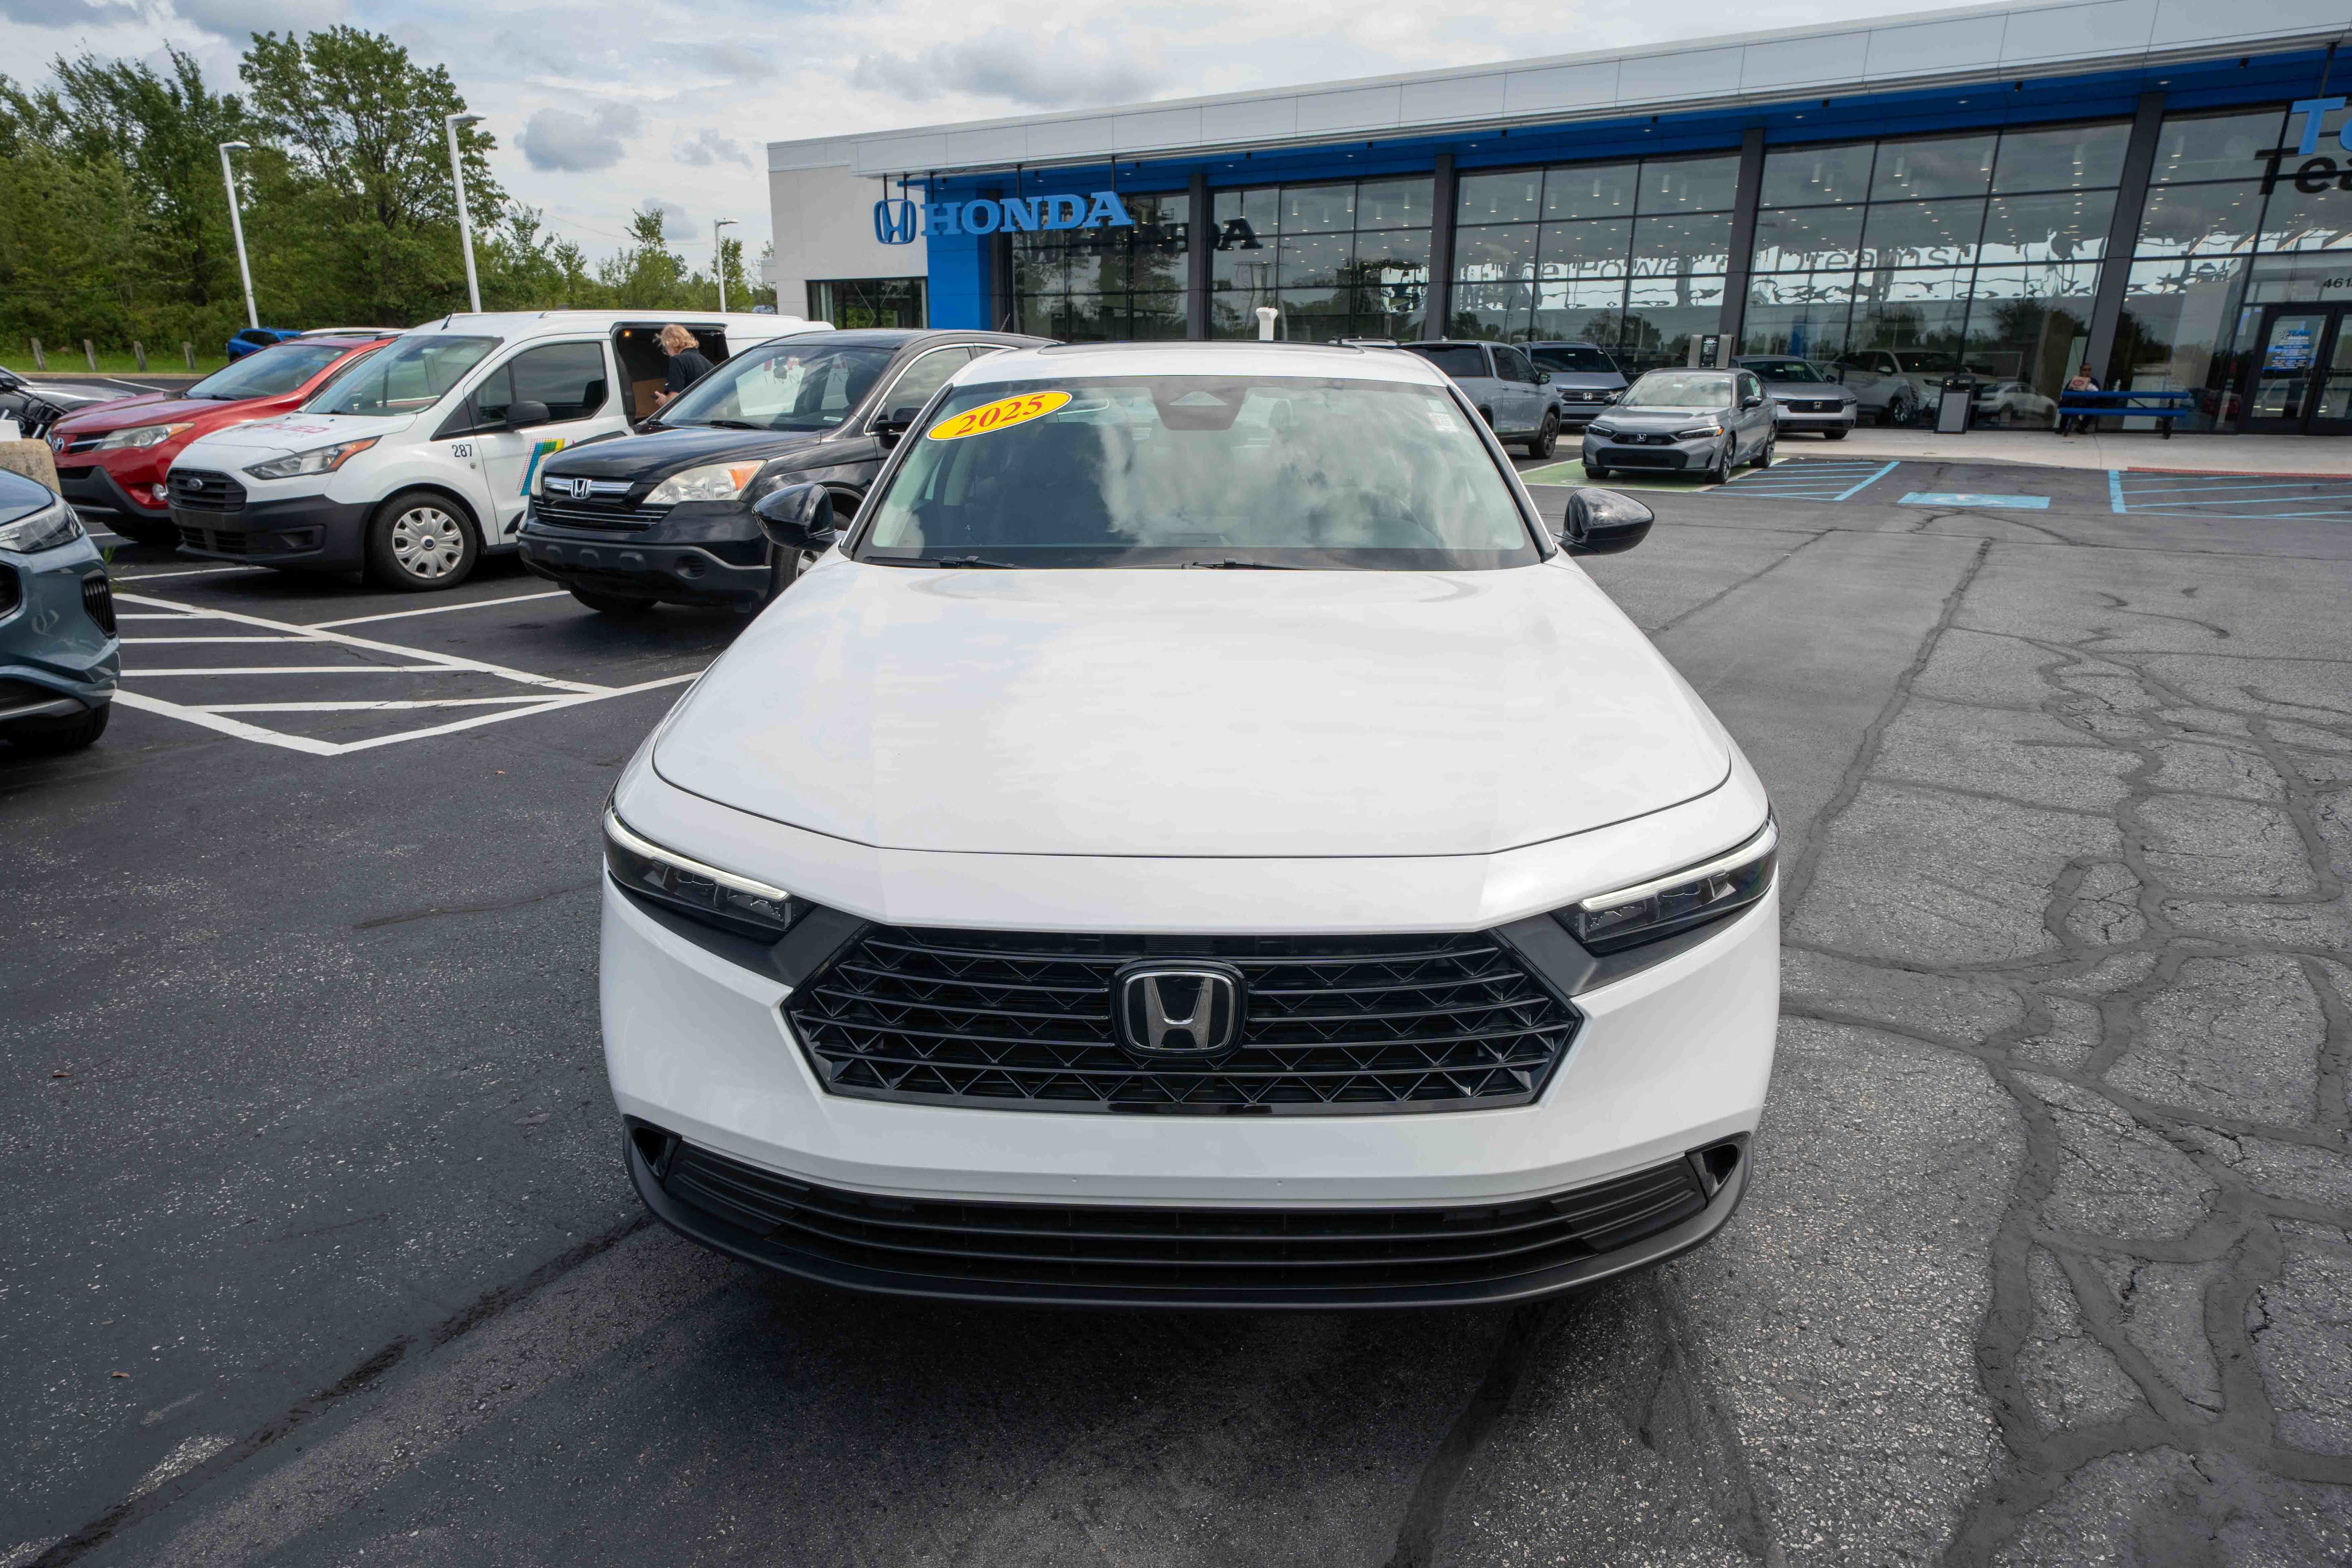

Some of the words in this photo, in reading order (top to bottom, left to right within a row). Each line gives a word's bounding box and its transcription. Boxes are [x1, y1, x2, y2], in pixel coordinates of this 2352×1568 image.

[2290, 96, 2352, 155] T
[920, 191, 1135, 236] HONDA
[2323, 277, 2352, 289] 461
[954, 394, 1046, 436] 2025
[452, 444, 472, 457] 287
